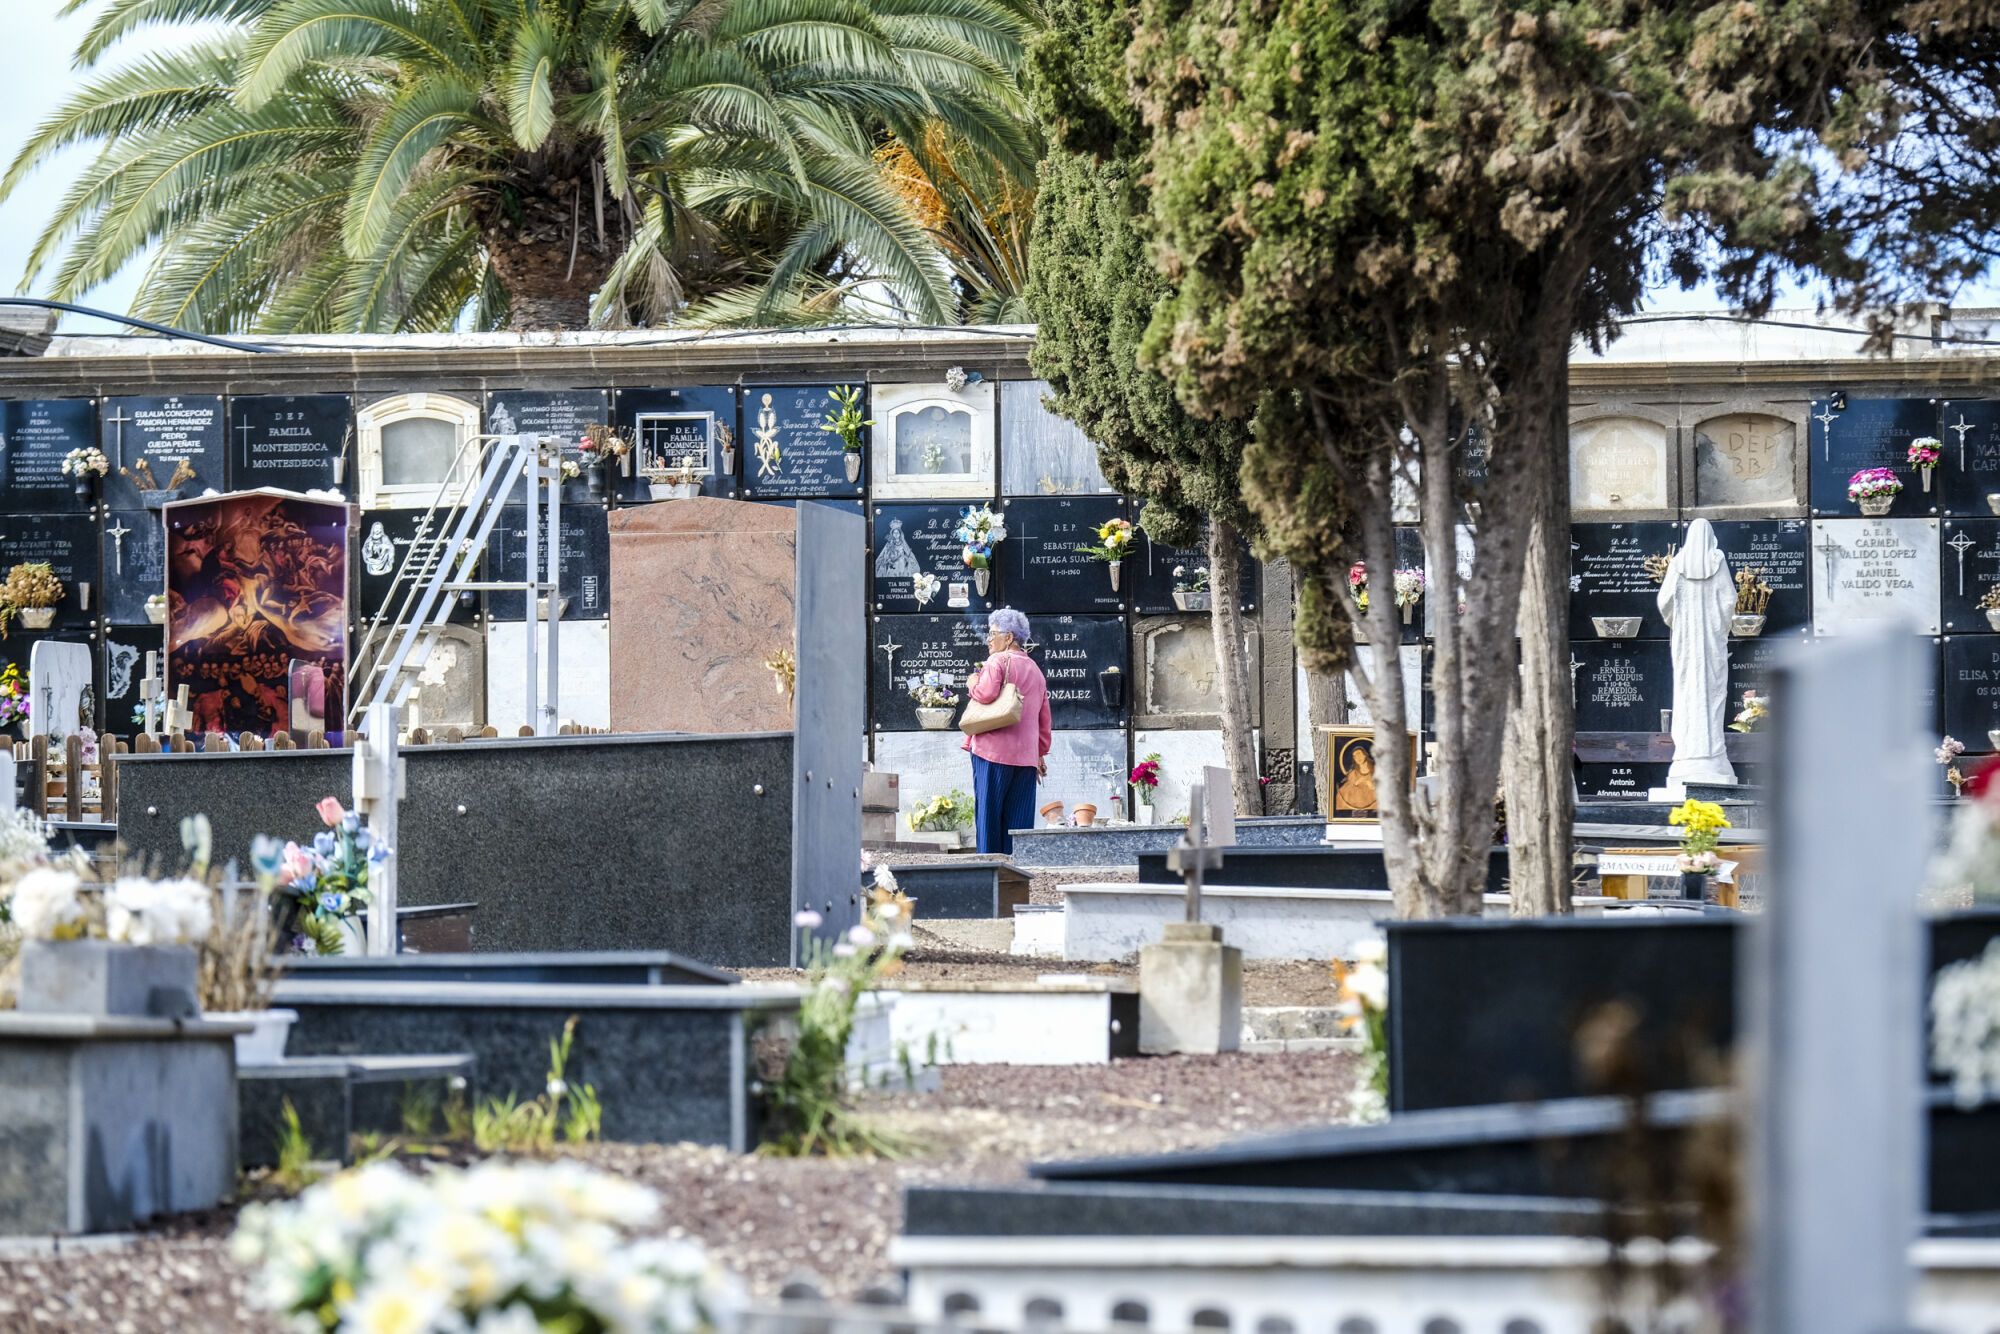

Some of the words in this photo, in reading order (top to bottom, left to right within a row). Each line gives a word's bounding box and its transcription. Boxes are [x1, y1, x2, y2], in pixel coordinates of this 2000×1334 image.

[165, 408, 214, 417] CONCEPCIÓN
[801, 408, 822, 418] Juan
[168, 418, 212, 426] HERNÁNDEZ
[268, 428, 312, 436] FAMILIA
[670, 434, 704, 442] FAMILIA
[790, 437, 826, 446] Mercedes
[252, 443, 328, 452] MONTESDEOCA
[806, 446, 842, 456] Quintana
[252, 459, 328, 468] MONTESDEOCA
[762, 475, 796, 484] Edelmira
[800, 474, 820, 484] Viera
[912, 530, 947, 542] Benigna
[1043, 542, 1088, 550] SEBASTIAN
[1855, 538, 1899, 547] CARMEN
[1840, 550, 1878, 559] VALIDO
[1882, 550, 1917, 558] LOPEZ
[1030, 556, 1068, 564] ARTEAGA
[1070, 555, 1095, 563] SUAR
[934, 561, 964, 570] Familia
[1856, 569, 1900, 577] MANUEL
[1842, 580, 1881, 588] VALIDO
[1886, 580, 1914, 588] VEGA
[1045, 650, 1087, 659] FAMILIA
[1047, 669, 1086, 678] MARTIN
[1960, 670, 1988, 680] ELISA
[1046, 690, 1091, 699] ONZALEZ
